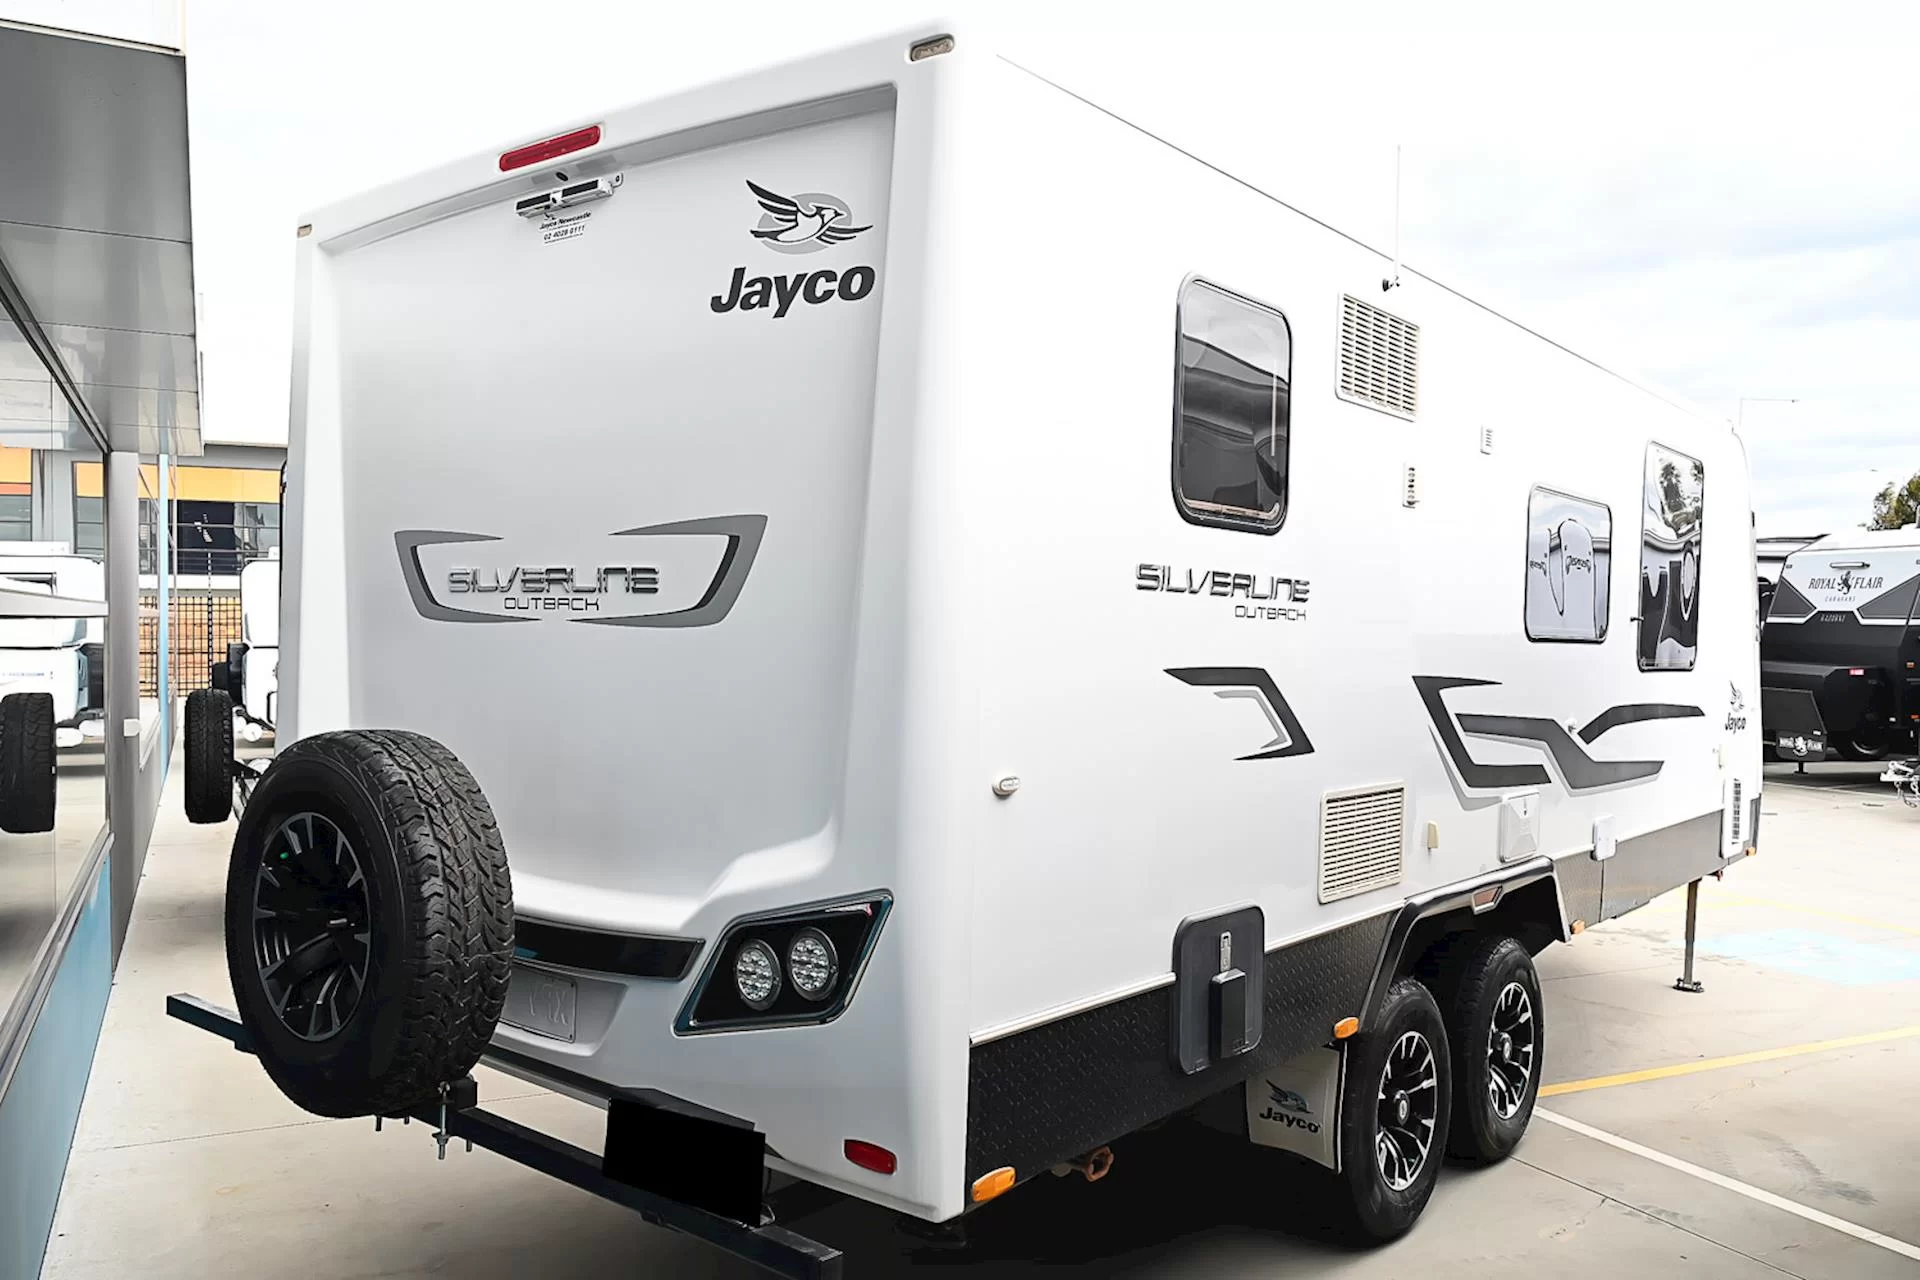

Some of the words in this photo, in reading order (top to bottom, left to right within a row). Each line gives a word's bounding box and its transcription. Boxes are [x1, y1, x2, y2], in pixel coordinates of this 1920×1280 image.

[710, 266, 876, 319] Jayco
[448, 566, 660, 594] SILVERLINE
[1136, 563, 1311, 603] SILVERLINE
[1808, 577, 1837, 590] ROYAL
[1853, 576, 1884, 589] FLAIR
[504, 597, 600, 611] OUTBACK
[1234, 604, 1307, 622] OUTBACK
[1725, 712, 1747, 735] Jayco
[1259, 1107, 1320, 1133] Jayco
